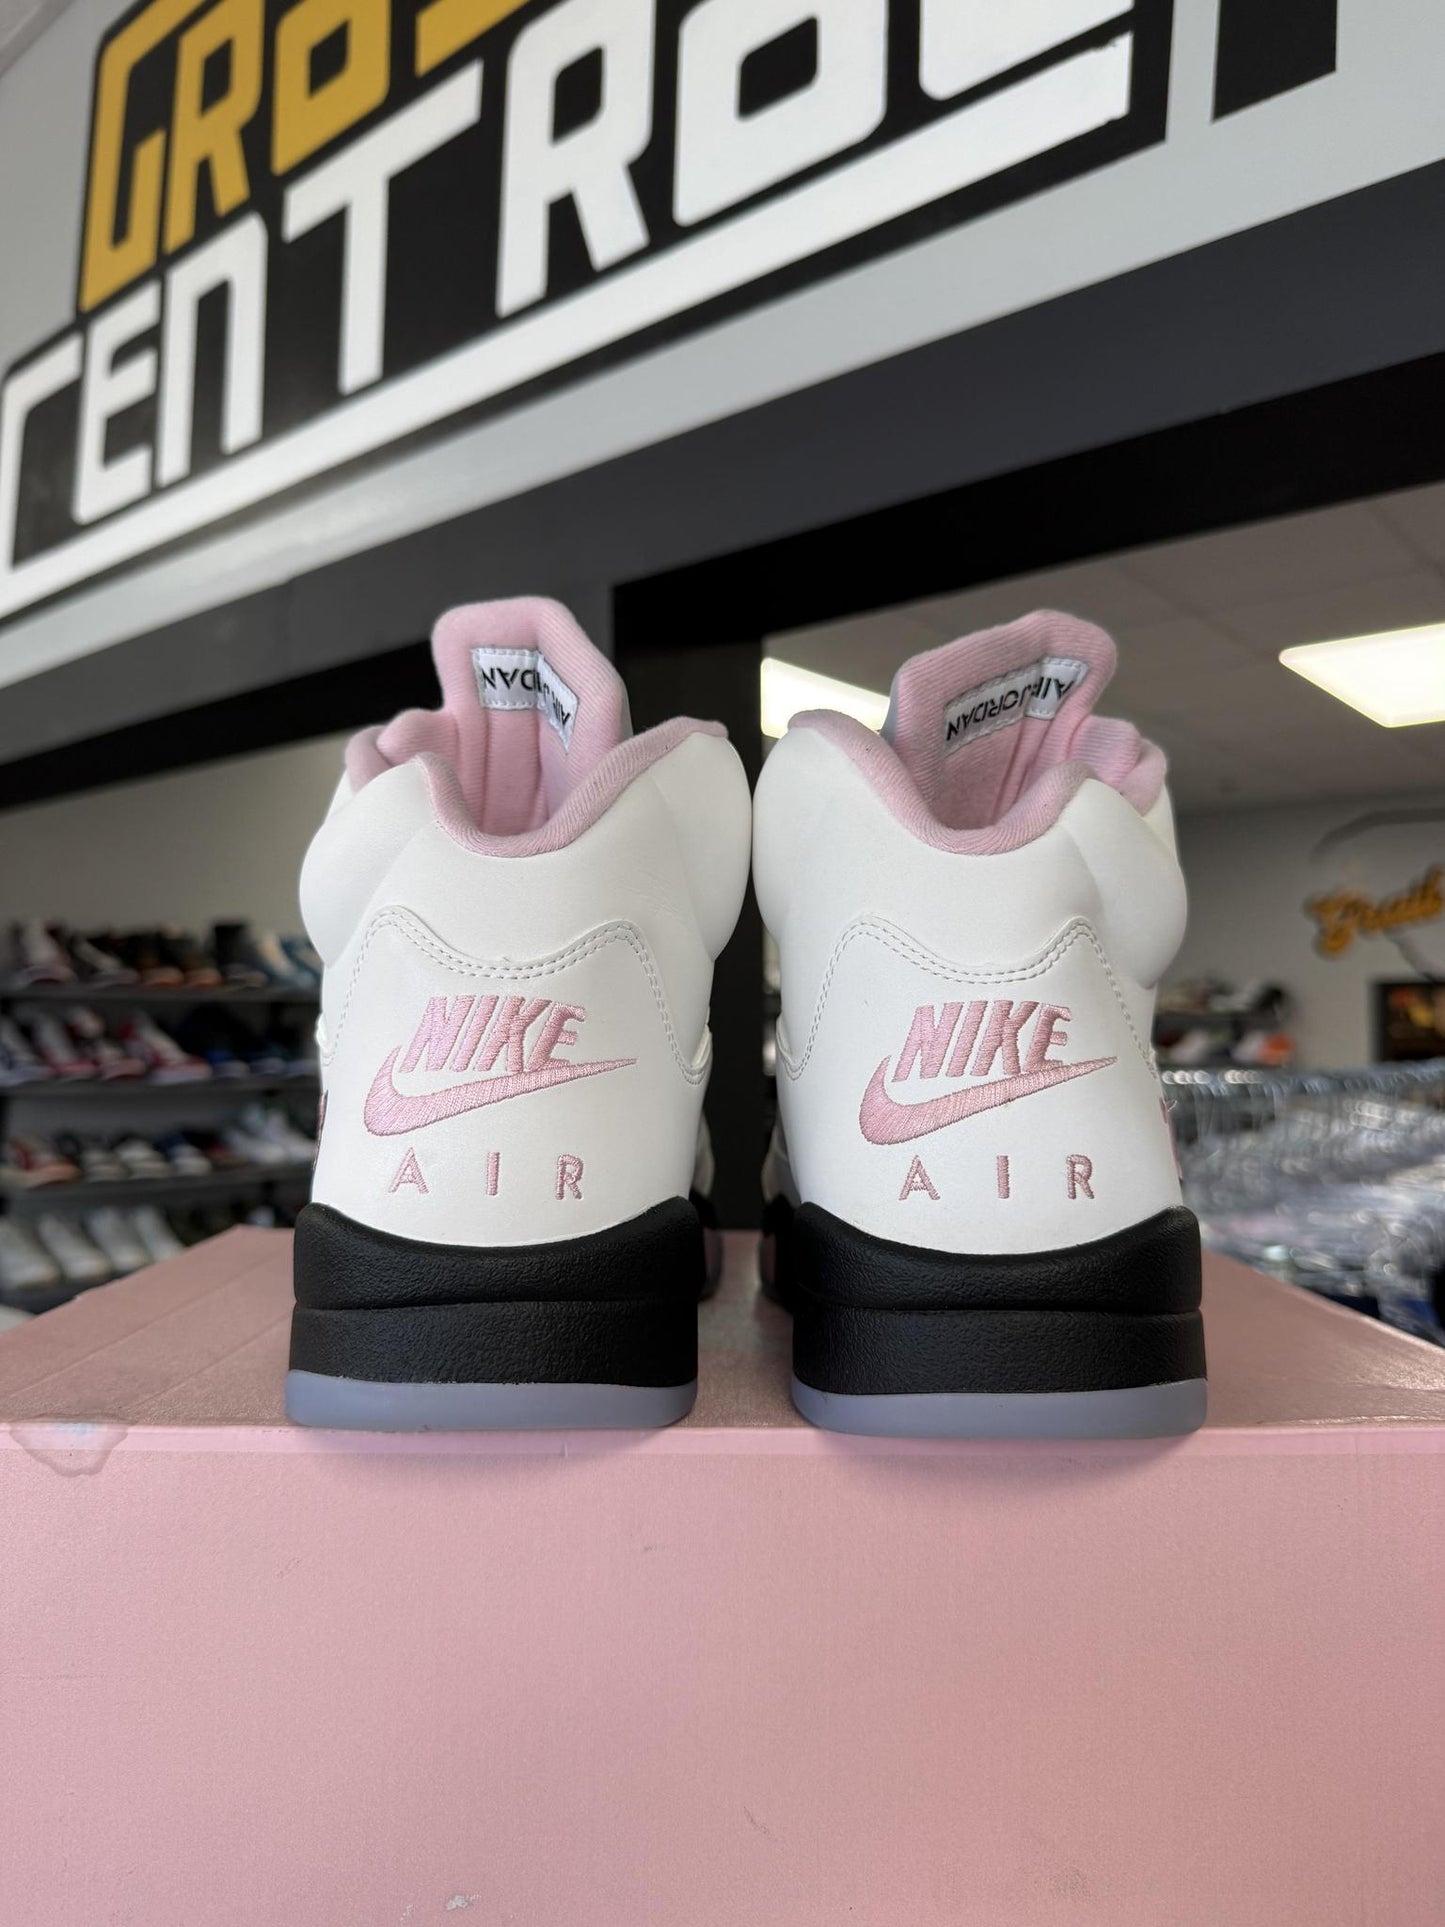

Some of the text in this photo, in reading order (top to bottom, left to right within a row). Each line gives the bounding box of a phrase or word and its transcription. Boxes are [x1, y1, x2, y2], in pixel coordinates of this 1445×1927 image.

[946, 683, 1031, 741] JORDAN
[399, 995, 586, 1074] NIKE
[891, 1000, 1072, 1082] NIKE
[388, 1147, 584, 1200] AIR
[899, 1154, 1094, 1200] AIR
